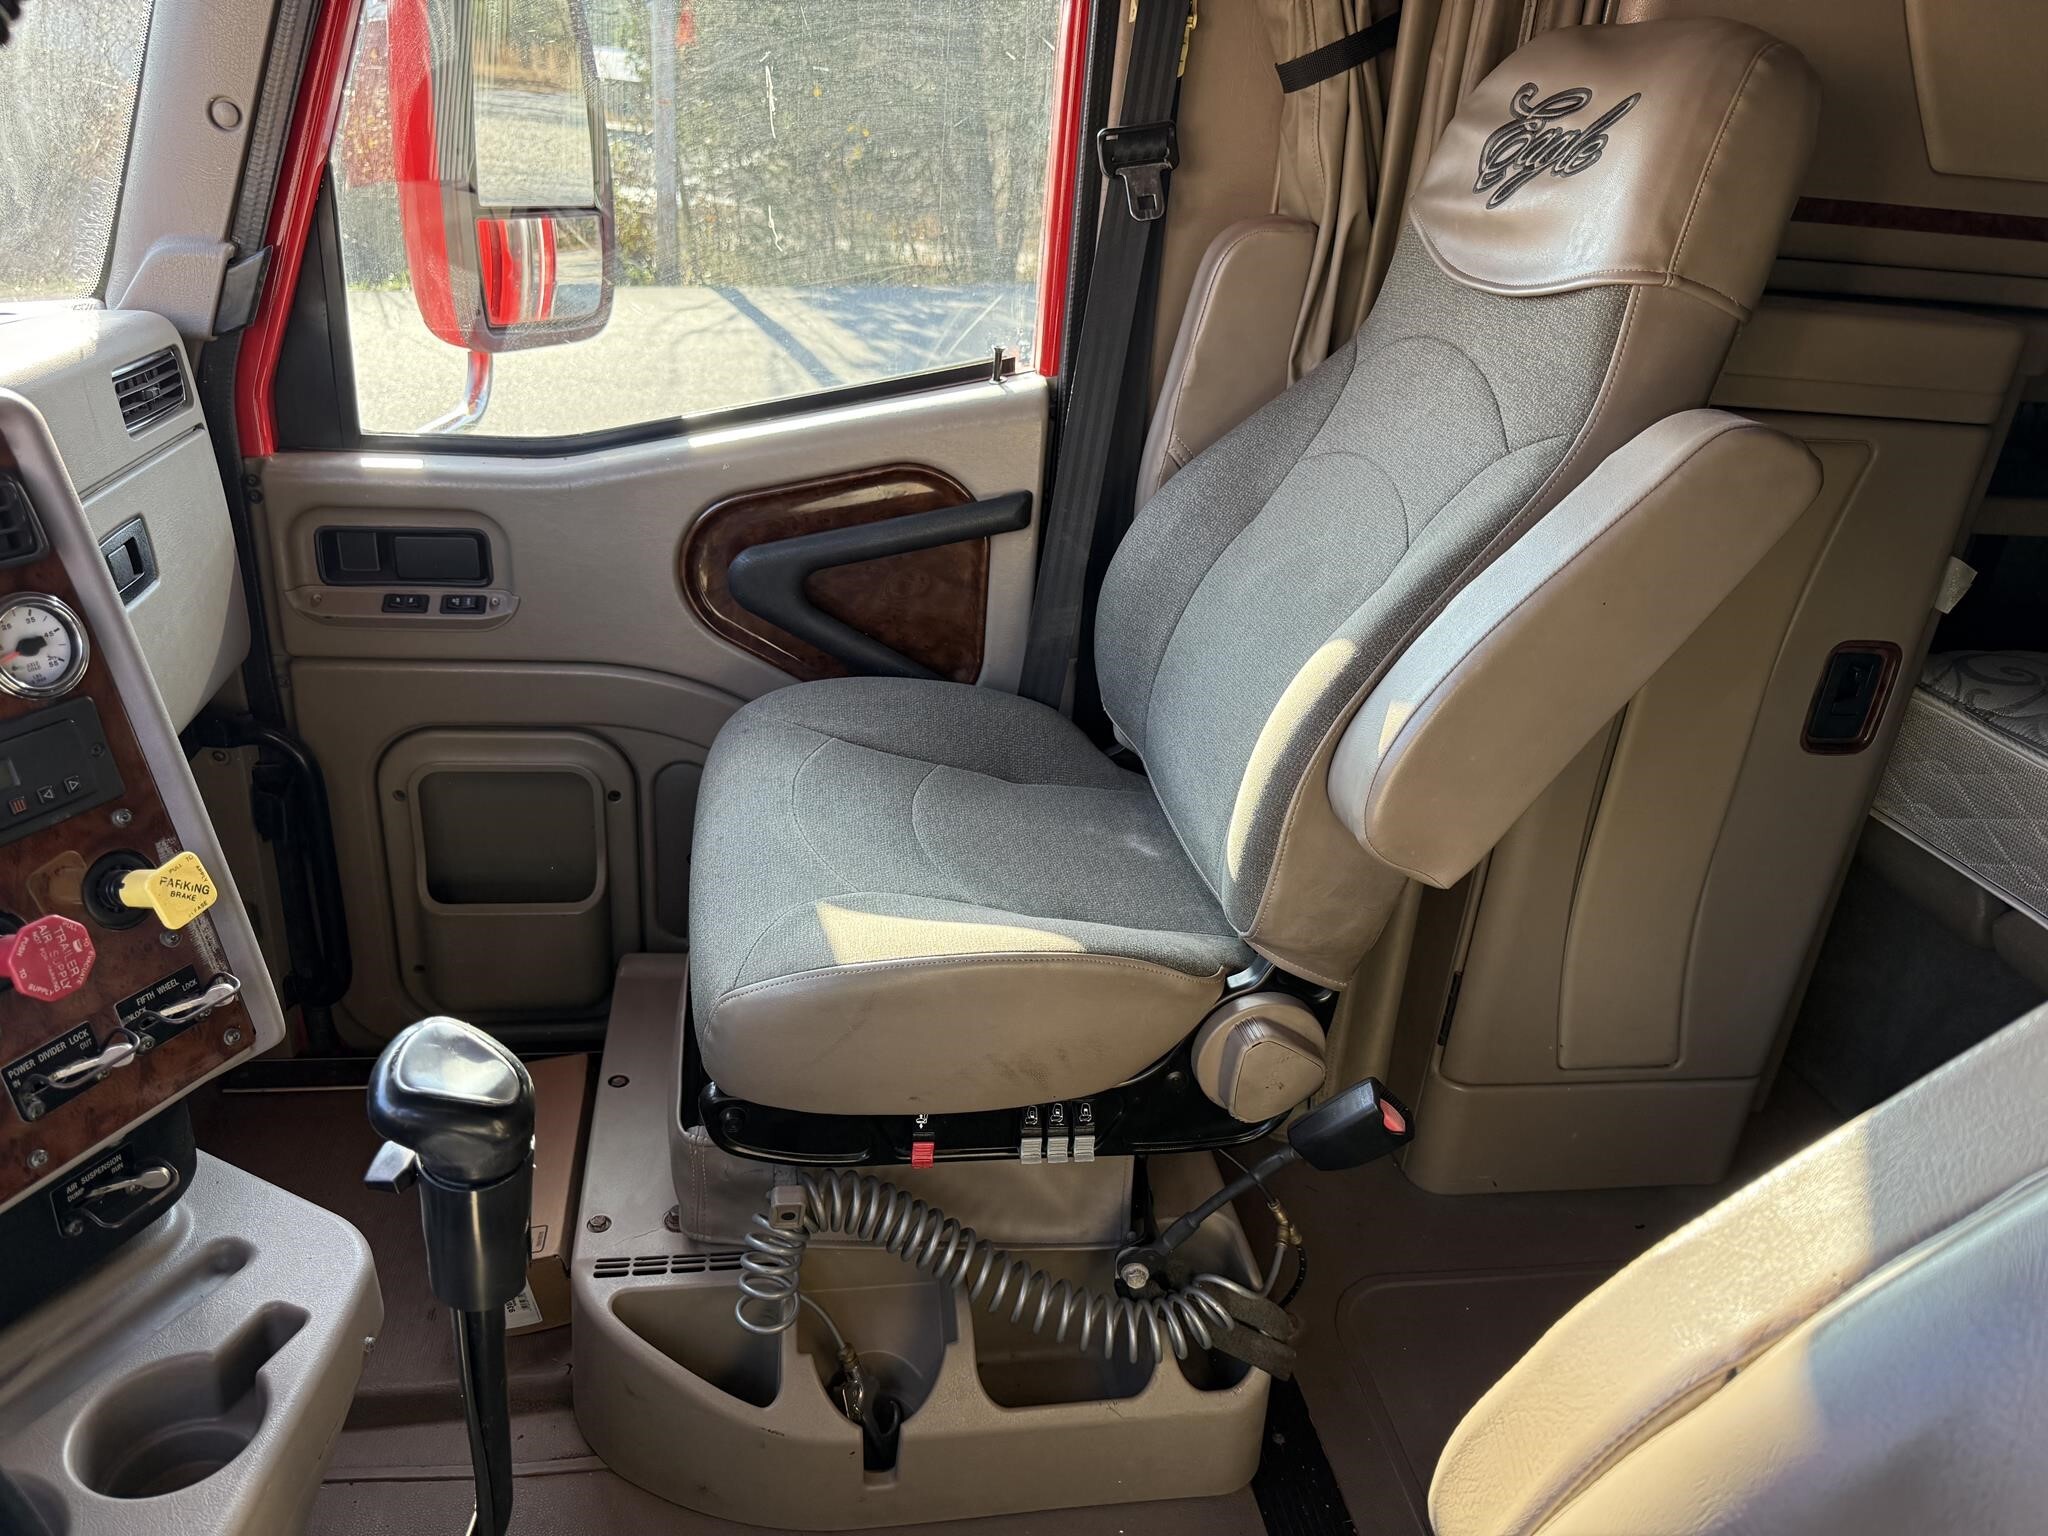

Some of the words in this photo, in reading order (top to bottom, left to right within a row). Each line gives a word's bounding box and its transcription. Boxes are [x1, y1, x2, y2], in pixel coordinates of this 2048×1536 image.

[168, 864, 182, 874] PULL
[185, 854, 194, 863] TO
[195, 864, 209, 883] APPLY
[159, 876, 210, 895] PARKING
[170, 890, 198, 902] BRAKE
[62, 921, 78, 931] PULL
[16, 936, 29, 957] PUSH
[32, 931, 42, 944] NOT
[40, 947, 48, 961] FOR
[54, 925, 80, 977] TRAILER
[83, 938, 90, 947] TO
[38, 925, 53, 943] AIR
[49, 950, 72, 989] SUPPLY
[19, 968, 27, 979] TO
[76, 950, 96, 984] EVACUATE
[28, 983, 54, 996] SUPPLY
[136, 991, 156, 1007] FIFTH
[156, 977, 180, 996] WHEEL
[181, 978, 198, 992] LOCK
[79, 1037, 93, 1051] OUT
[8, 1059, 36, 1080] POWER
[37, 1042, 68, 1063] DIVIDER
[69, 1028, 90, 1047] LOCK
[12, 1079, 21, 1089] IN
[66, 1182, 78, 1195] AIR
[80, 1154, 122, 1185] SUSPENSION
[111, 1162, 124, 1174] RUN
[67, 1186, 85, 1202] DUMP
